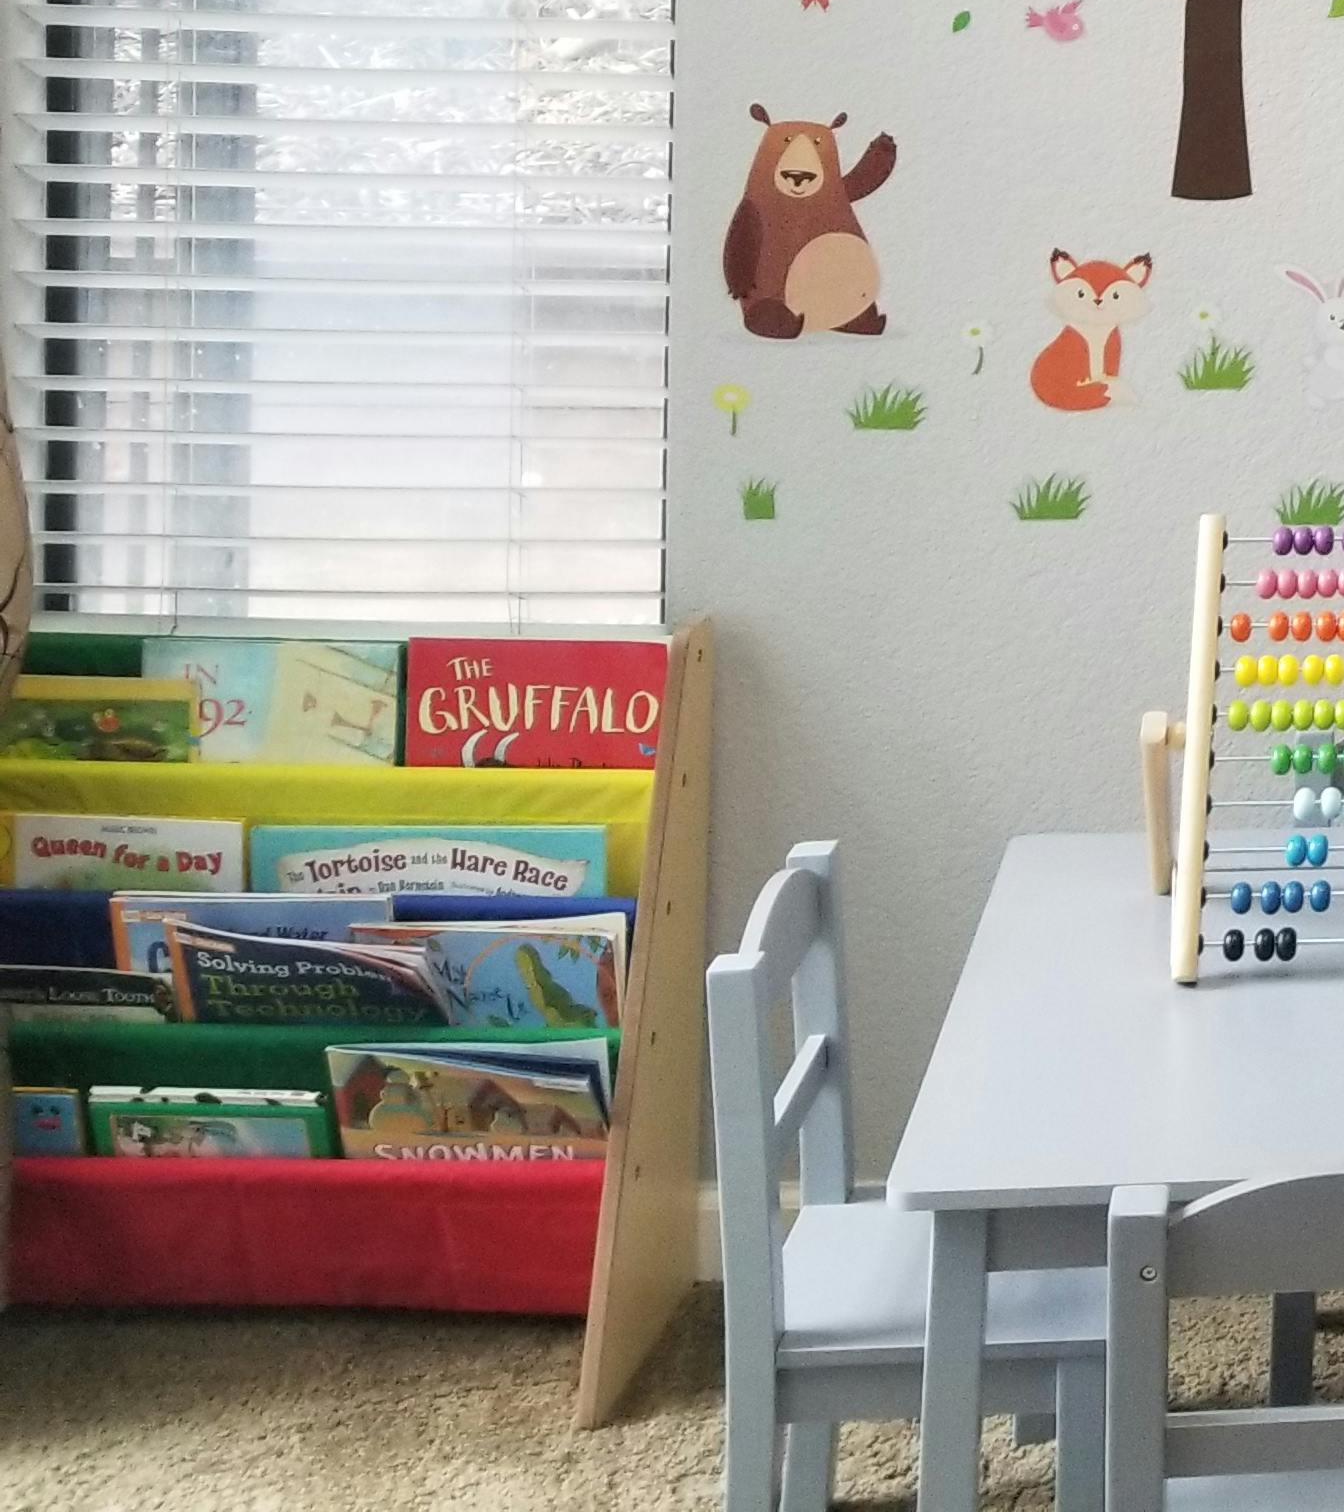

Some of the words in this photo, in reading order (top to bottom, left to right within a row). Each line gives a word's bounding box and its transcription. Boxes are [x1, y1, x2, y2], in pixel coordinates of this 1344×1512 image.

[448, 657, 493, 681] THE
[418, 685, 660, 735] GRUFFALO
[31, 837, 107, 858] Queen
[113, 844, 151, 870] for
[157, 855, 170, 872] a
[176, 851, 223, 875] Day
[305, 849, 407, 883] Tortoise
[411, 853, 428, 865] and
[451, 847, 507, 876] Hare
[514, 860, 568, 891] Race
[197, 953, 289, 977] Solving
[201, 974, 360, 999] Through
